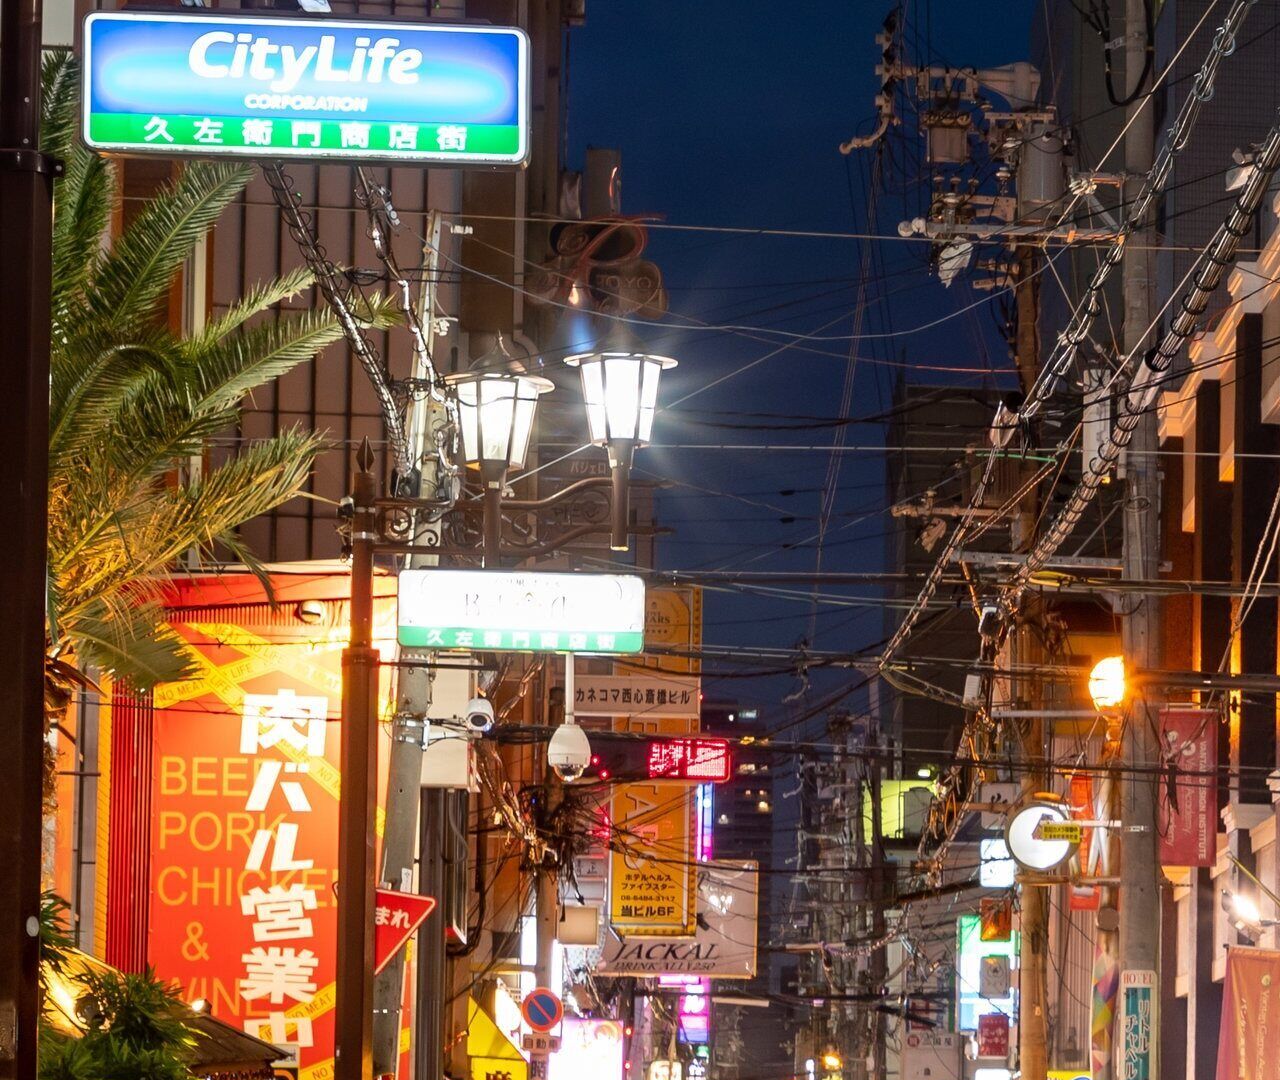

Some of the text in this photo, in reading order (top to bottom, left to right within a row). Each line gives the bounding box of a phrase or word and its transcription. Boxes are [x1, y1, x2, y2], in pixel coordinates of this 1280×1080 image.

[188, 31, 423, 92] CityLife
[244, 93, 368, 113] CORPORATION
[144, 115, 467, 152] 久左衛門商店街
[159, 810, 287, 852] PORK
[240, 688, 328, 1048] 肉バル営業中
[620, 905, 675, 917] 当ビル6F
[180, 922, 210, 961] &
[610, 942, 722, 963] JACKAL
[1138, 999, 1150, 1054] リトル
